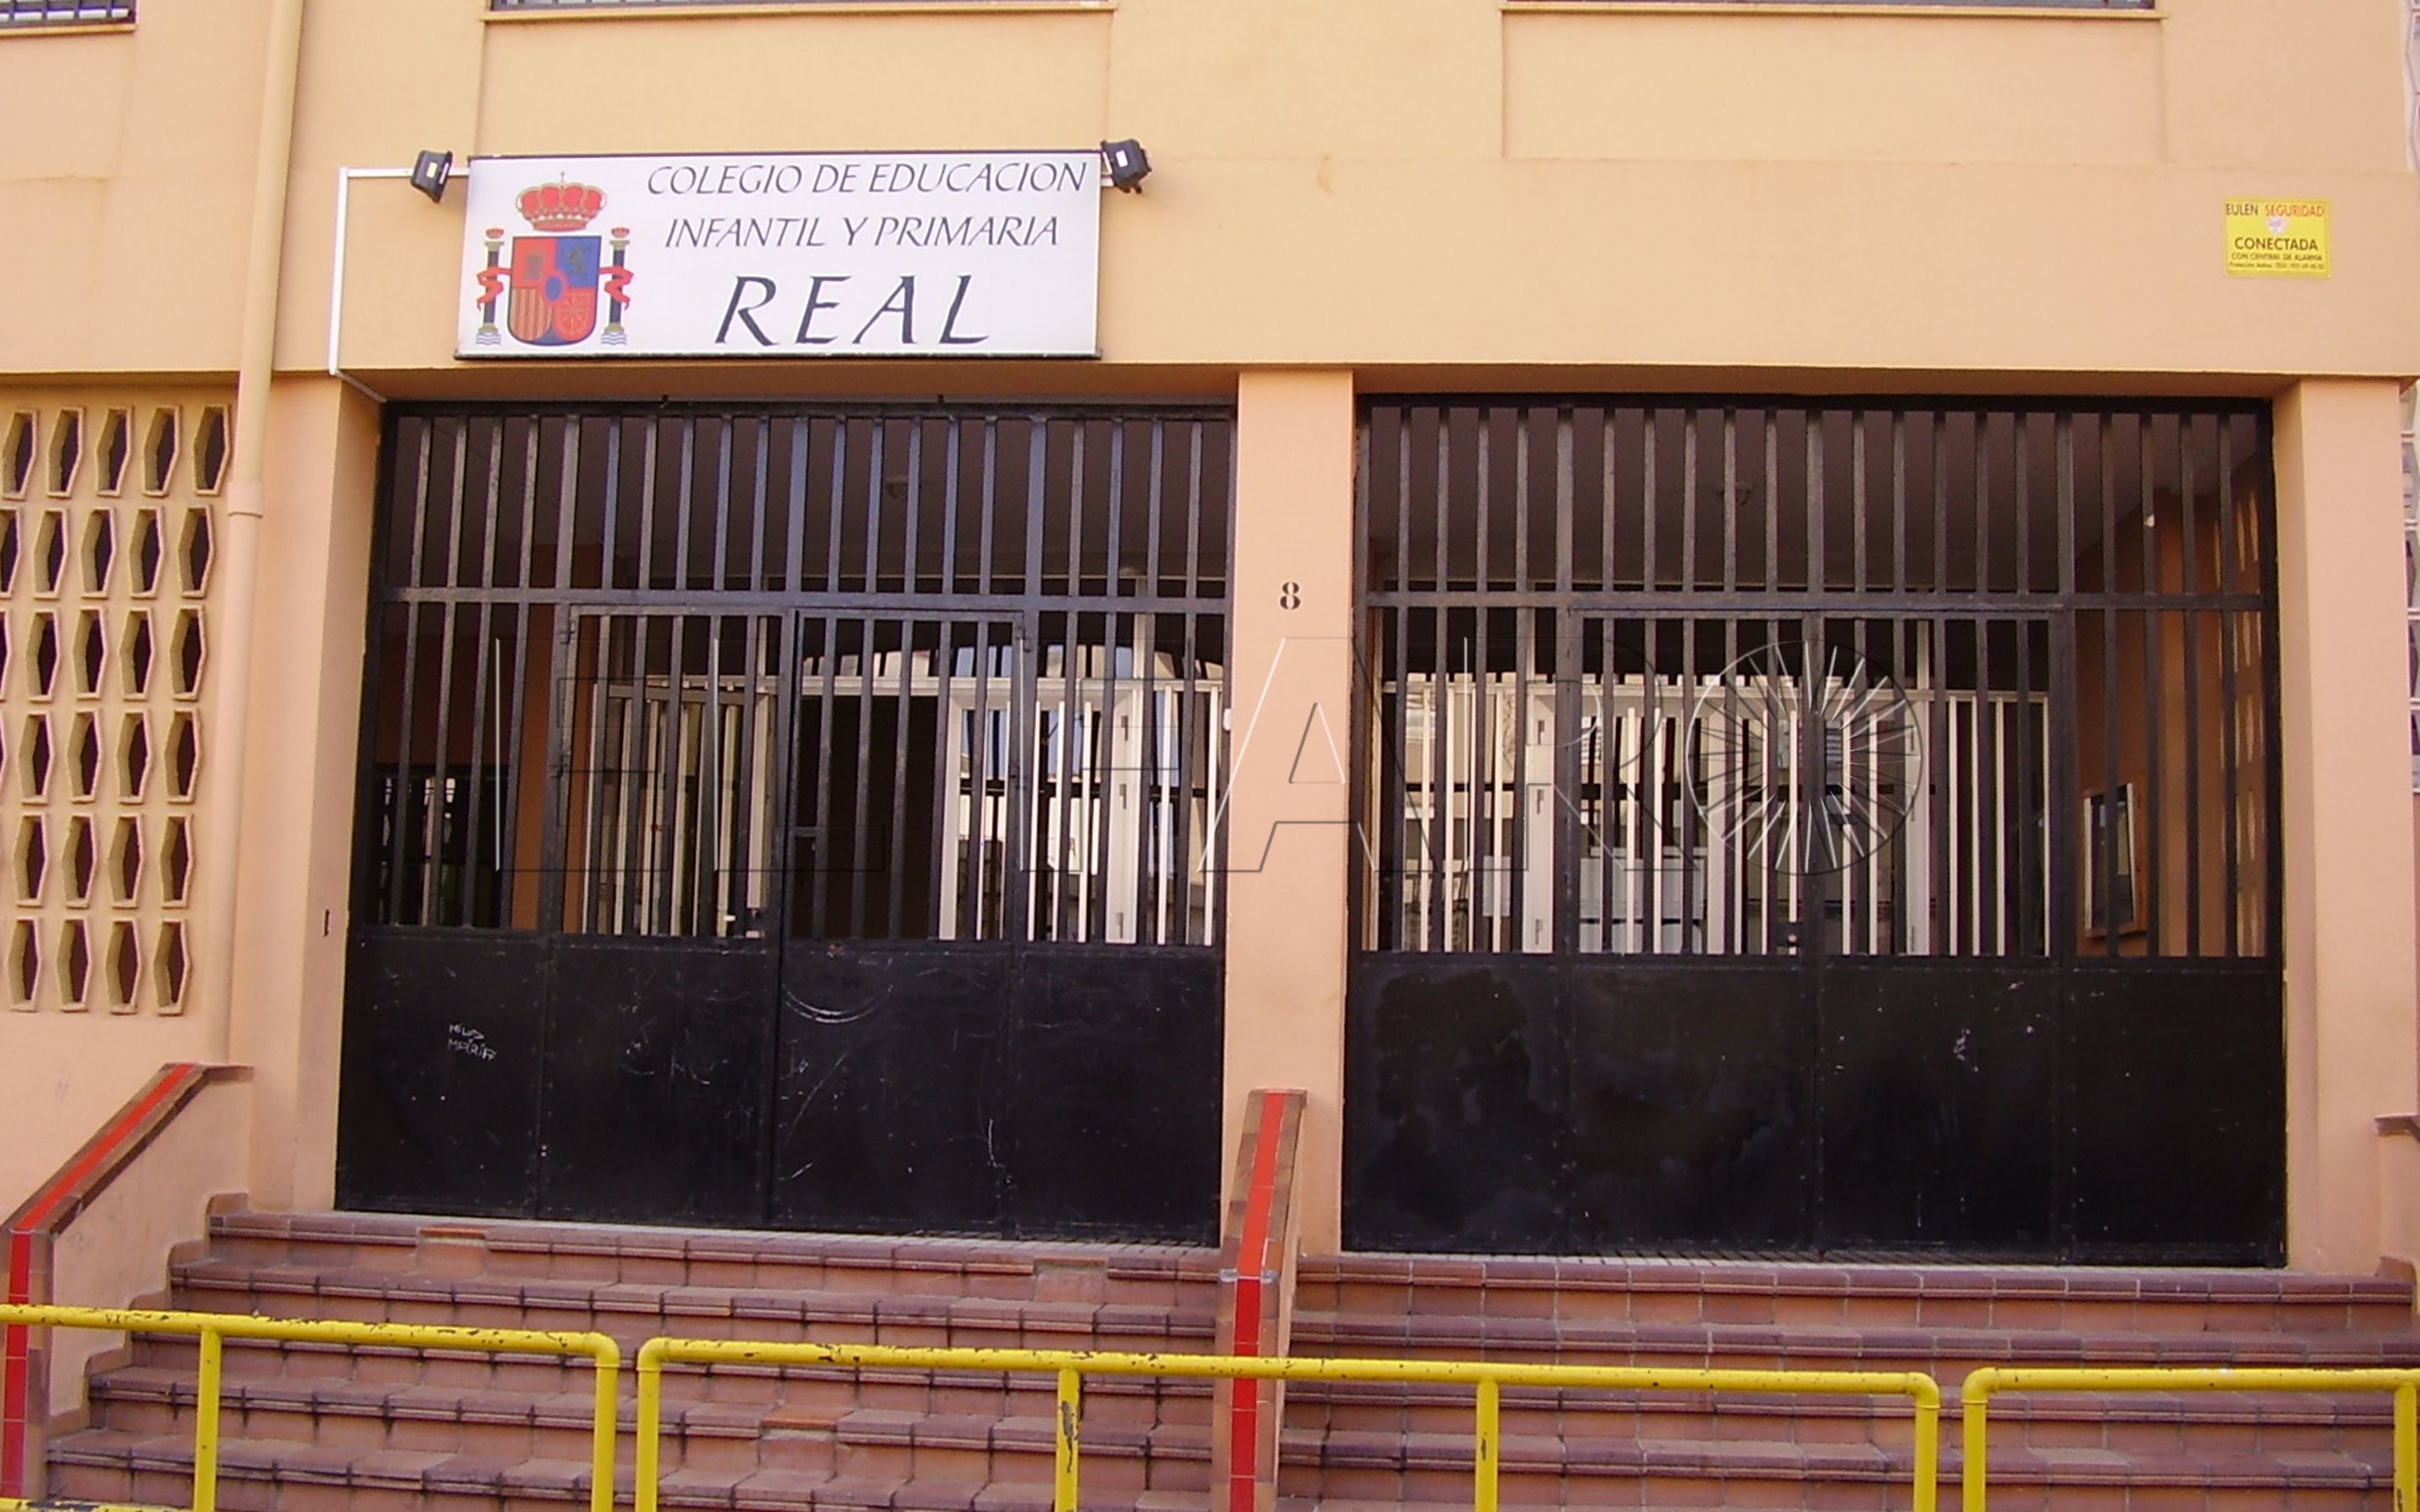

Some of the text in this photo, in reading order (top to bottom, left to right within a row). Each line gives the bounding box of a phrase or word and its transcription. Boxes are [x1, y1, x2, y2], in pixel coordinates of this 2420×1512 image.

[648, 161, 1087, 195] COLEGIO DE EDUCACION
[2225, 203, 2325, 217] EULEN SEGURIDAD
[665, 216, 1058, 248] INFANTIL Y PRIMARIA
[2234, 237, 2318, 251] CONECTADA
[714, 274, 989, 346] REAL
[1280, 581, 1301, 610] 8
